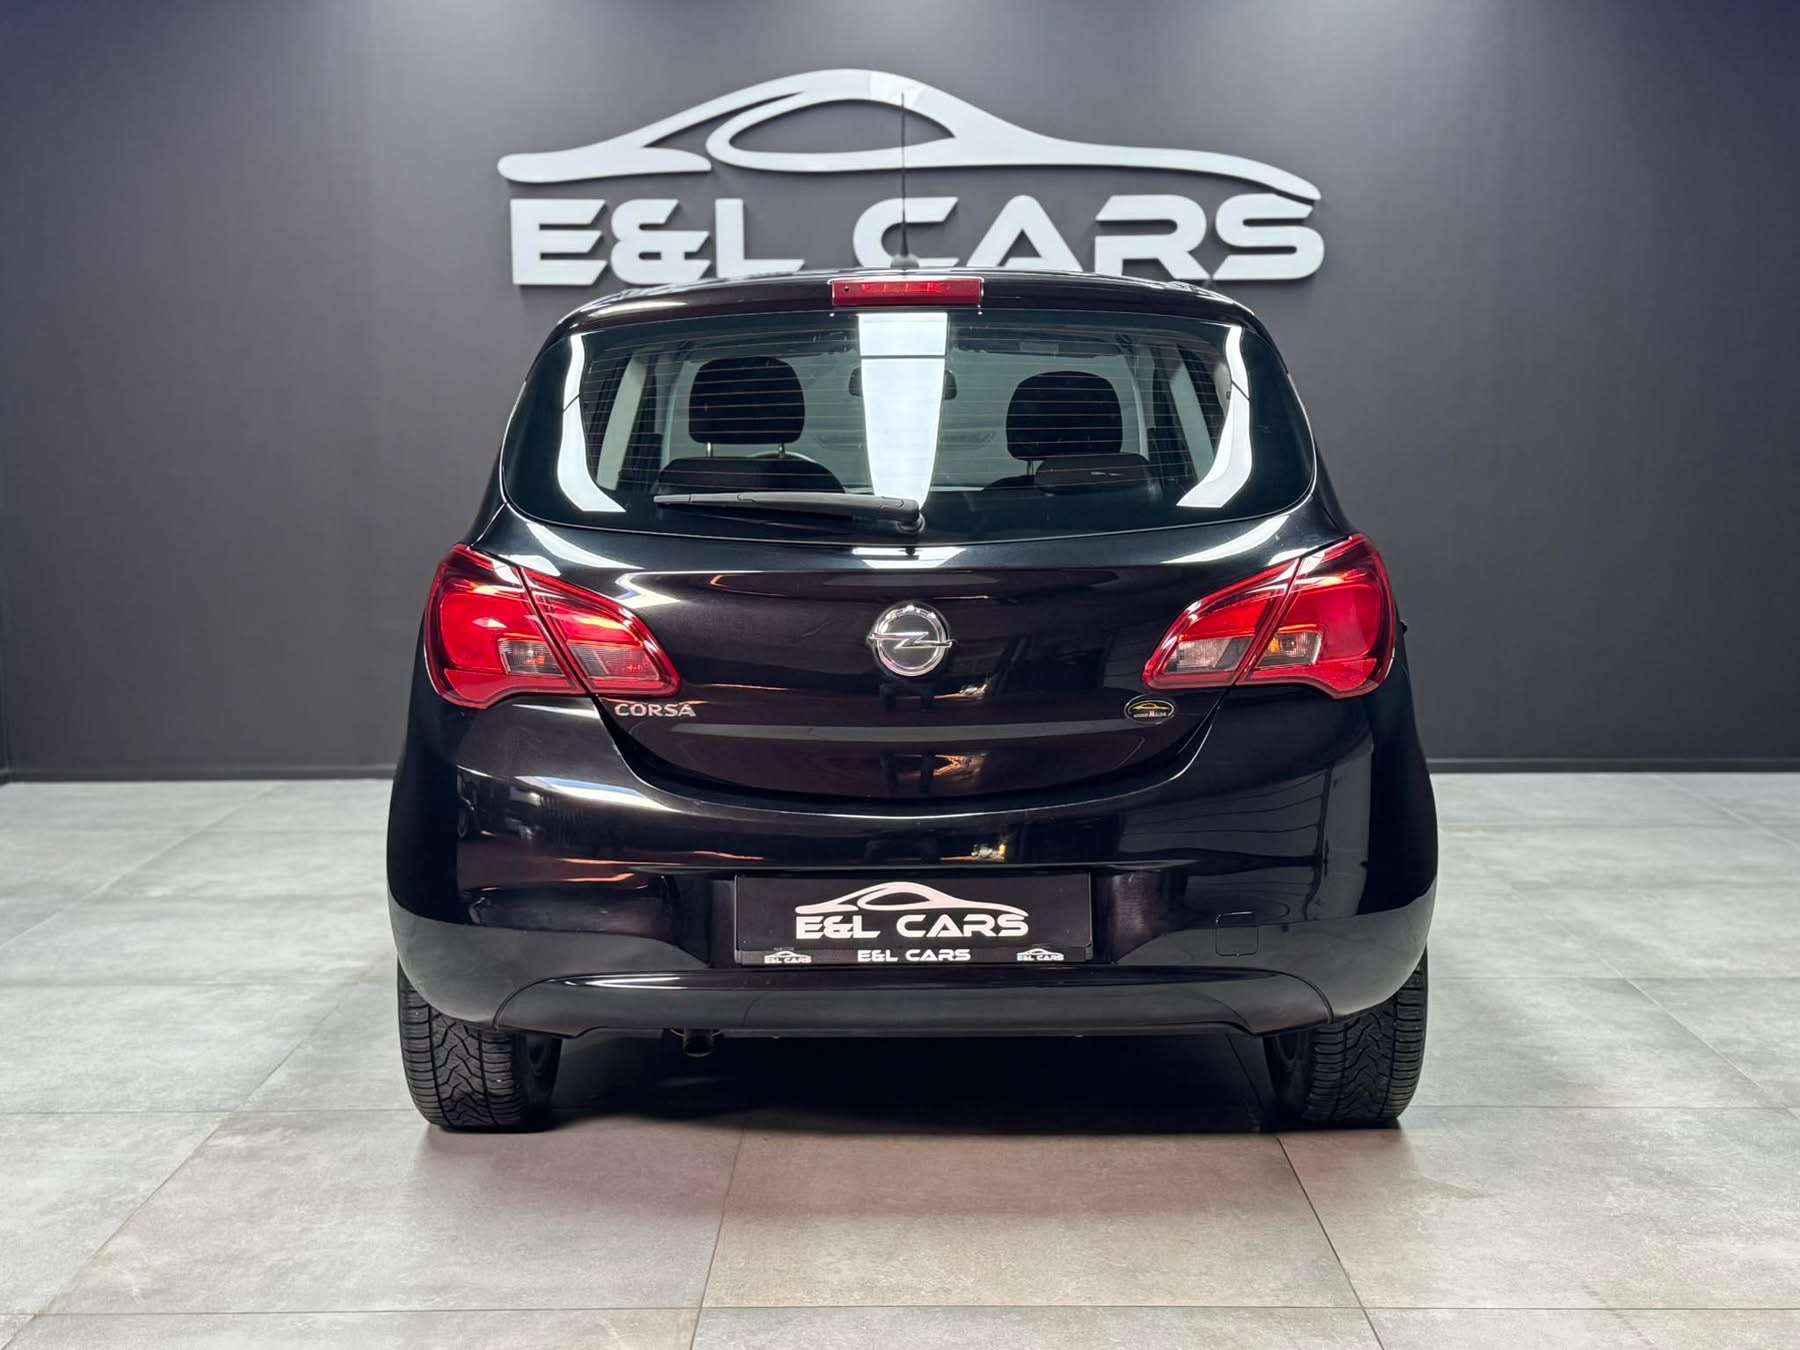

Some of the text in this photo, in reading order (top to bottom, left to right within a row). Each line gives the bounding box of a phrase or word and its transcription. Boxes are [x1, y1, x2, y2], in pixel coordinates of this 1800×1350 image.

[510, 194, 1325, 286] E&L CARS
[614, 703, 697, 717] CORSA
[796, 914, 1029, 939] E&L CARS
[857, 948, 972, 962] E&L CARS
